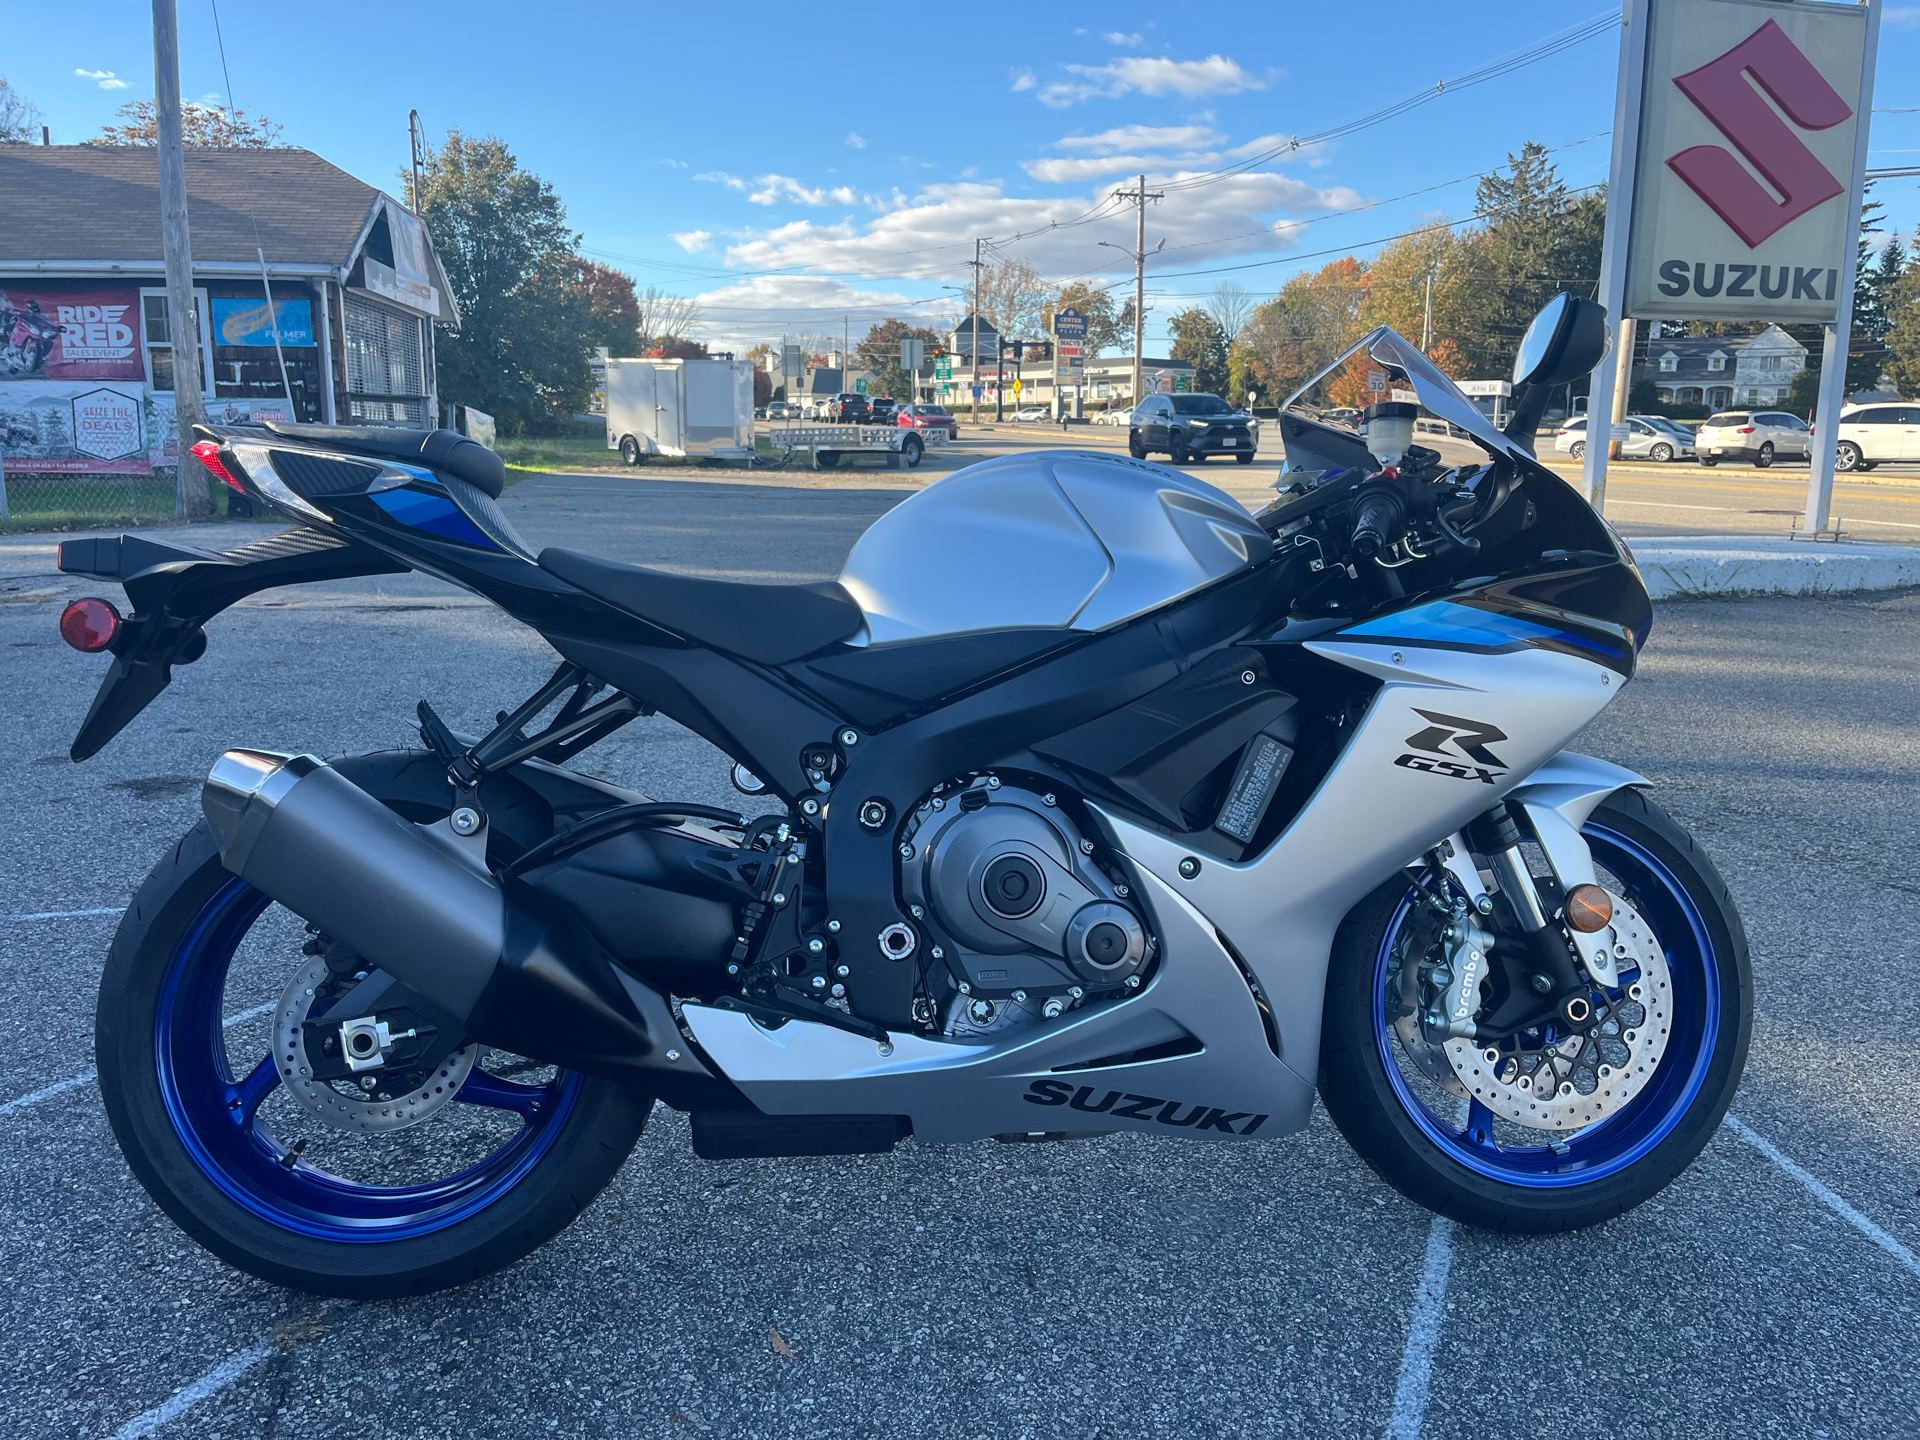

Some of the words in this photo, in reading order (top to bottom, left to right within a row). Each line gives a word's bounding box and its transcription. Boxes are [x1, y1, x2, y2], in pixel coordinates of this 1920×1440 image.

[1657, 259, 1838, 300] SUZUKI
[57, 305, 130, 323] RIDE
[60, 323, 133, 347] RED
[65, 349, 91, 357] SALES
[1371, 382, 1384, 390] 30
[84, 407, 108, 416] SEIZE
[112, 407, 129, 417] THE
[83, 421, 132, 431] DEALS
[1405, 707, 1510, 769] R
[1394, 754, 1507, 784] GSX
[1454, 951, 1480, 1018] brembo
[1022, 1079, 1270, 1136] SUZUKI
